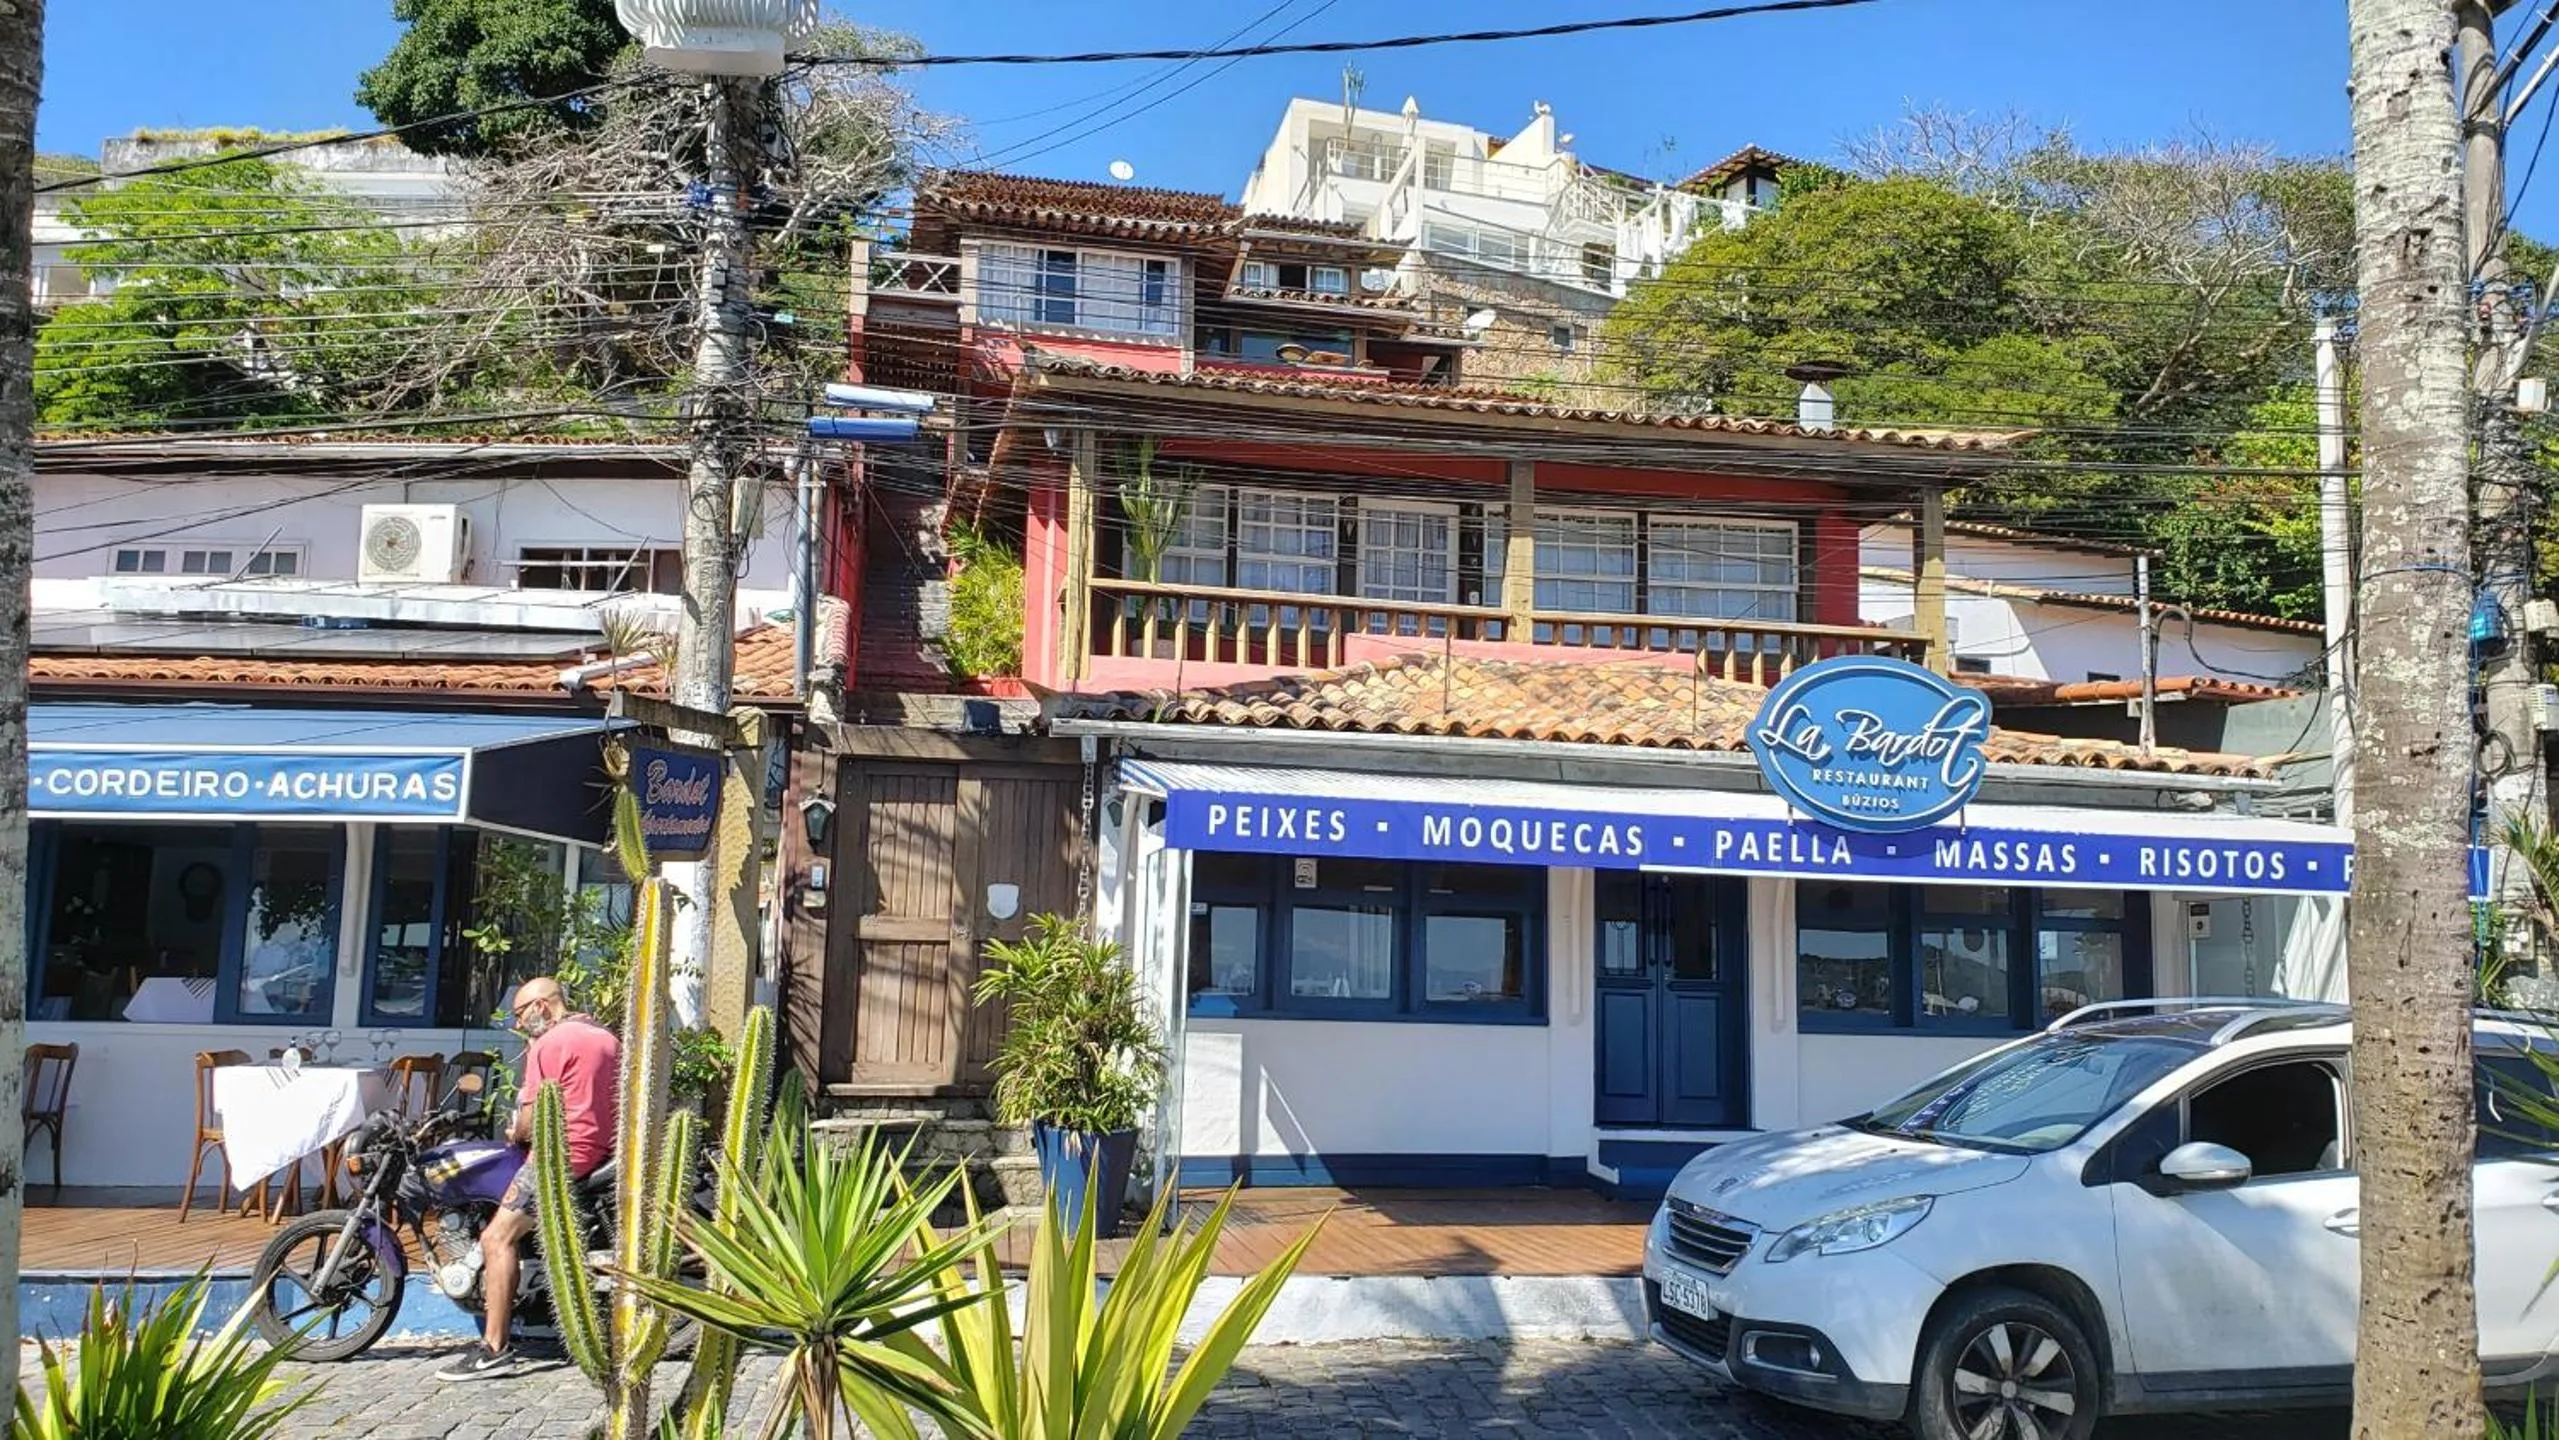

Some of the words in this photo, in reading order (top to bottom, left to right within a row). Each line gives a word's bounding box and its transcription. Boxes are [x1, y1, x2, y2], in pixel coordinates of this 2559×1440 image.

[1757, 704, 1832, 760] La
[1835, 695, 1985, 787] Bardot
[46, 768, 250, 800] CORDEIRO
[266, 771, 458, 801] ACHURAS
[1811, 767, 1930, 790] RESTAURANT
[1840, 792, 1901, 811] BÚZIOS
[1208, 803, 1346, 842] PEIXES
[1422, 814, 1643, 858] MOQUECAS
[1714, 829, 1853, 866] PAELLA
[1934, 838, 2077, 874] MASSAS
[2139, 846, 2286, 881] RISOTOS
